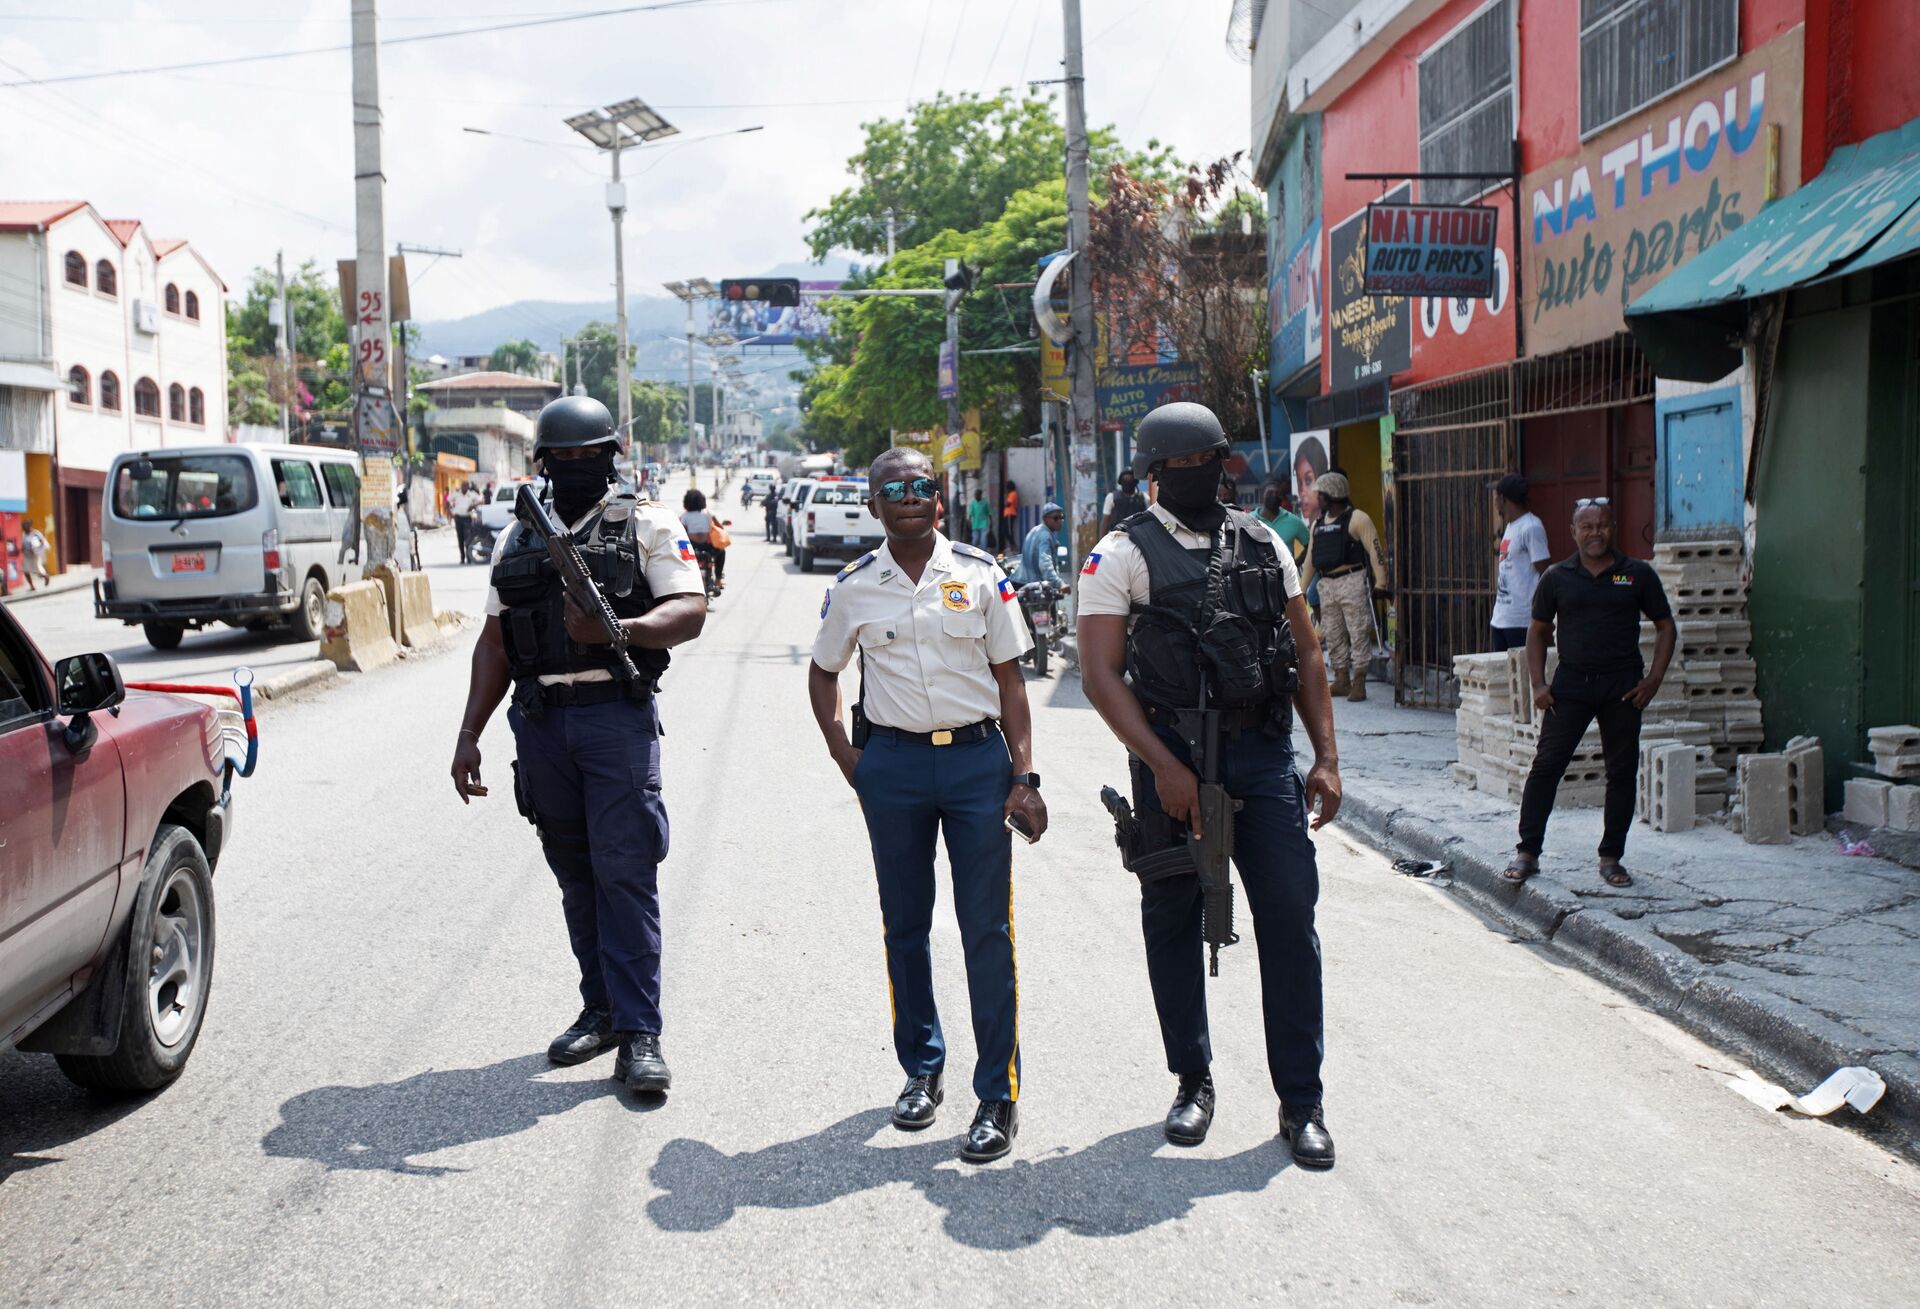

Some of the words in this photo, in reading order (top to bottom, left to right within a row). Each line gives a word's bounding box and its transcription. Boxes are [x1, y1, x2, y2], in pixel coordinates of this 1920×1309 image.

[1371, 208, 1491, 246] NATHOU
[1620, 176, 1745, 307] parts
[1373, 247, 1421, 272] AUTO
[1425, 248, 1485, 275] PARTS
[360, 291, 382, 312] 95
[1331, 295, 1376, 330] VANESSA
[360, 339, 384, 363] 95
[1104, 402, 1149, 418] PARTS
[1110, 389, 1145, 406] AUTO
